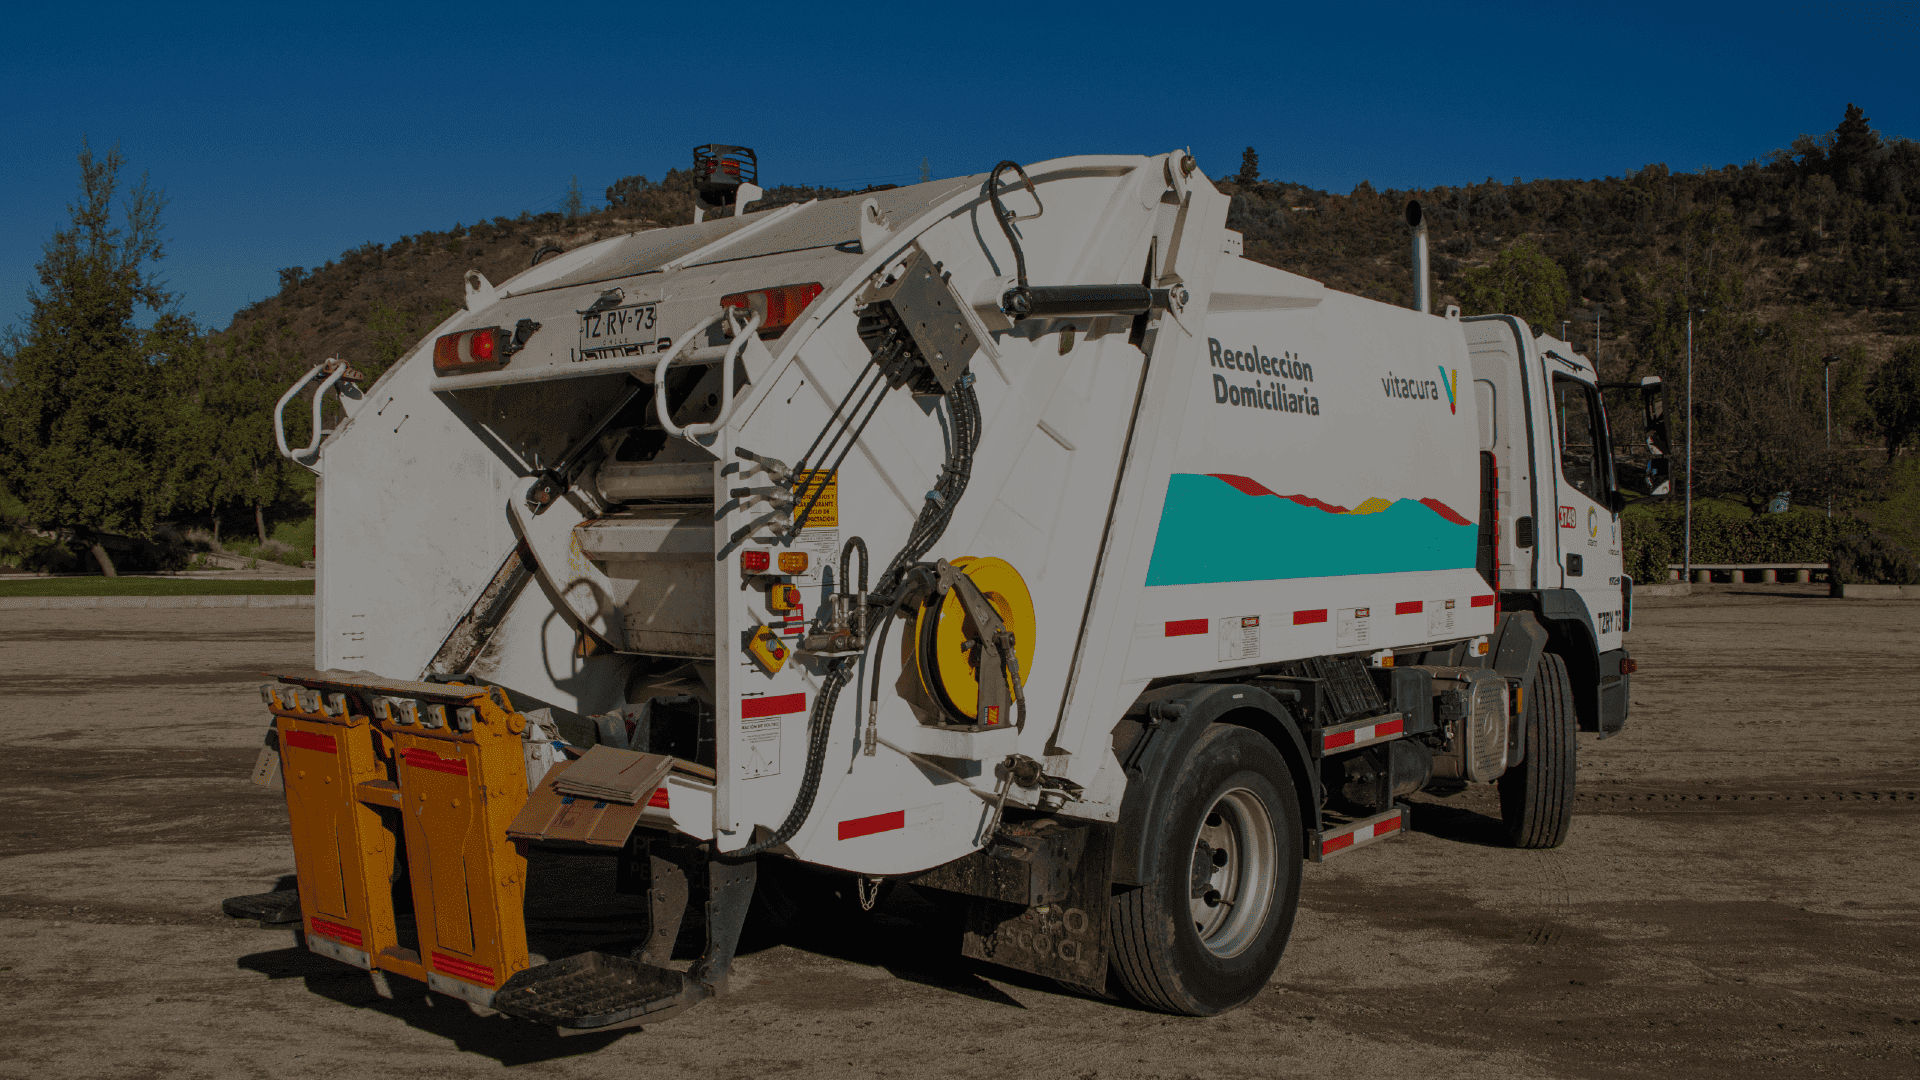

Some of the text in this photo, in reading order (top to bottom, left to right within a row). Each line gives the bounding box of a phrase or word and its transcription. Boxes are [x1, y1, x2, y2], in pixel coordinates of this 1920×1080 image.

[1207, 337, 1314, 382] Recolección
[1213, 373, 1320, 416] Domiciliaria
[1381, 371, 1439, 401] vitacura
[1598, 611, 1613, 635] TZRY
